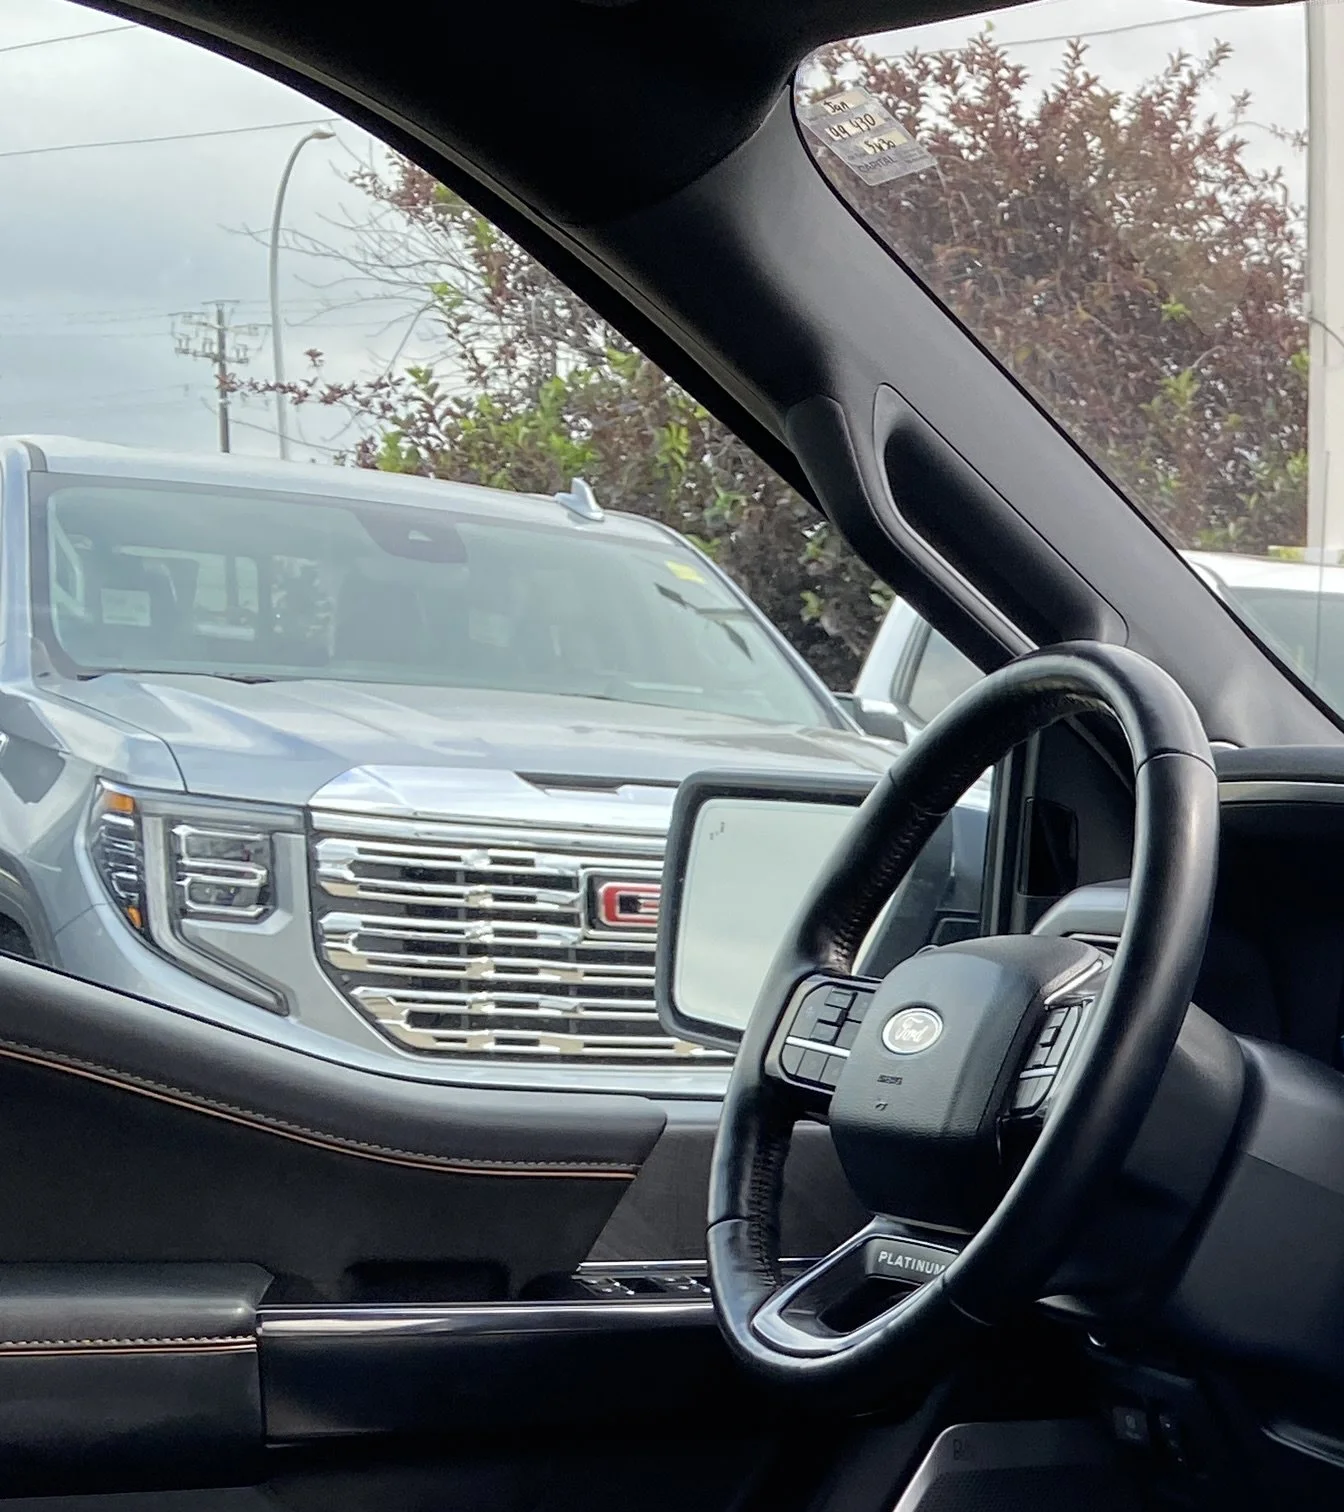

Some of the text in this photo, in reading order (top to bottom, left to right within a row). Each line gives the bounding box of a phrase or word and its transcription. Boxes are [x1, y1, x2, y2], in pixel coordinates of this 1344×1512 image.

[823, 100, 851, 113] Jan
[850, 113, 877, 133] 430
[858, 156, 896, 173] CAPITAL
[894, 1015, 929, 1042] Ford
[877, 1250, 946, 1276] PLATINUM
